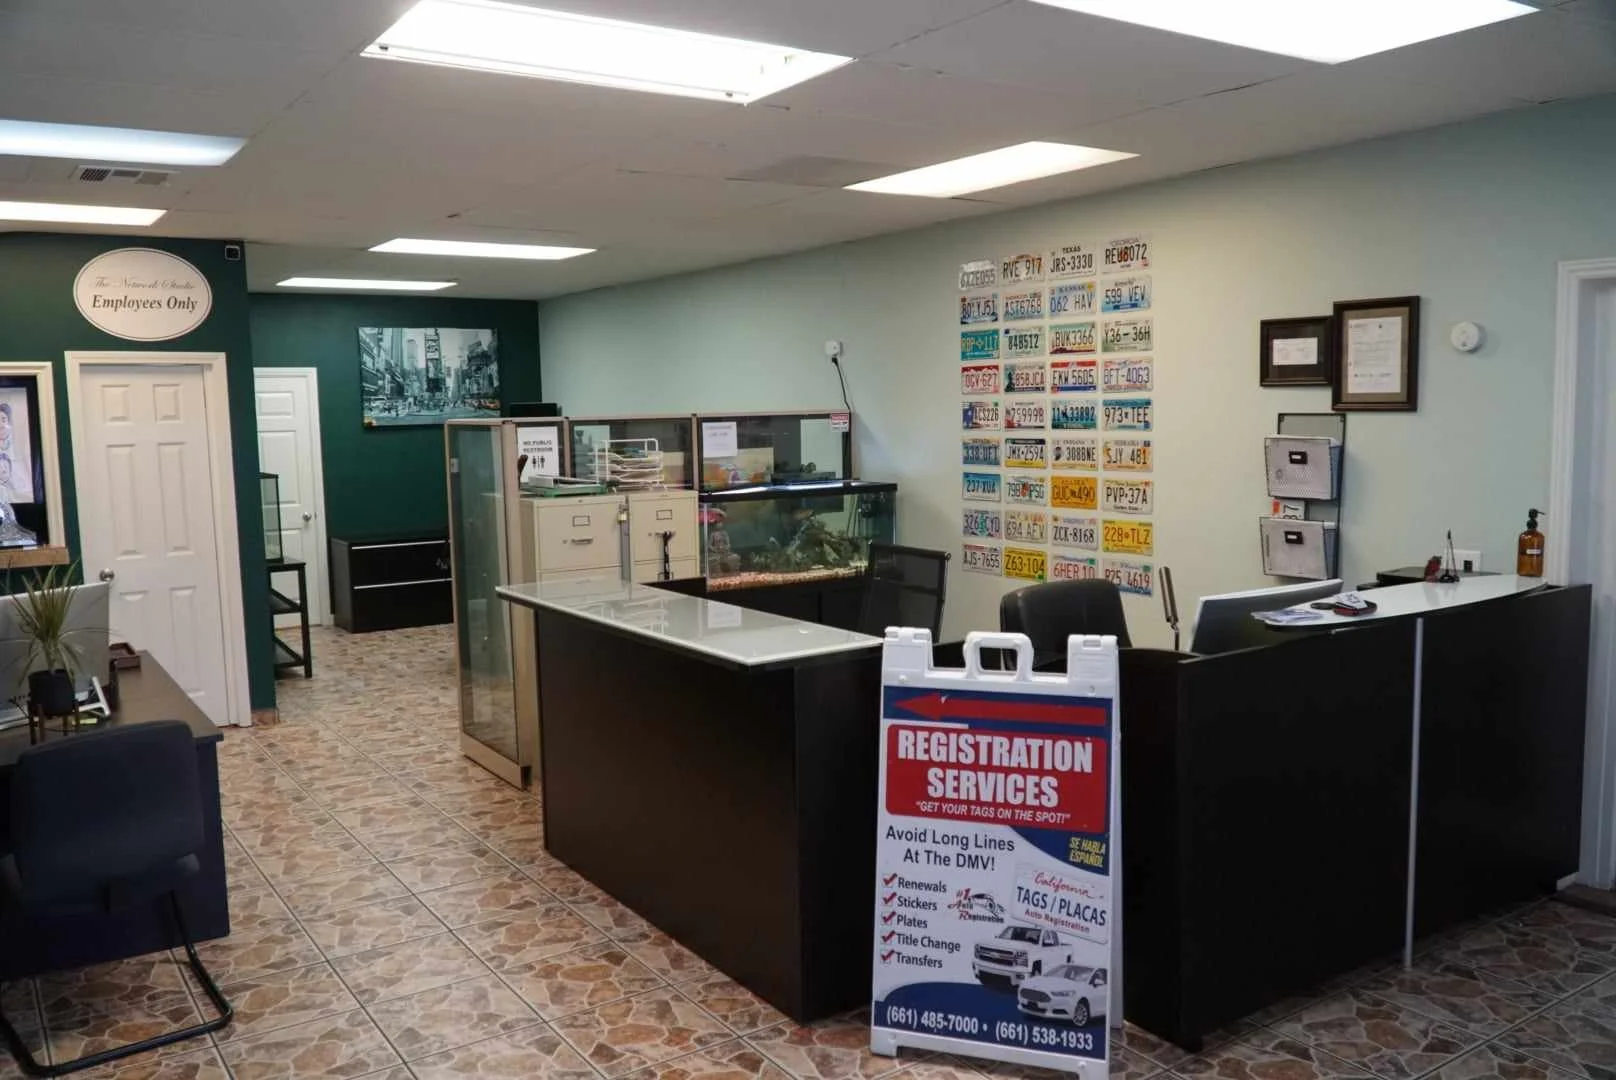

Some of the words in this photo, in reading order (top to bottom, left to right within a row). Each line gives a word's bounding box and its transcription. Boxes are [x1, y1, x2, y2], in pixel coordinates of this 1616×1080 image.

[1062, 245, 1081, 255] TEXAS
[1003, 260, 1020, 280] RVE
[1025, 258, 1042, 276] 917
[92, 294, 162, 312] Employees
[166, 296, 198, 313] Only
[898, 729, 1093, 773] REGISTRATION
[927, 767, 1059, 808] SERVICES
[916, 800, 940, 812] "GET
[941, 803, 968, 815] YOUR
[969, 805, 995, 818] TAGS
[997, 807, 1013, 818] ON
[1014, 808, 1034, 821] THE
[1035, 811, 1071, 824] SPOT!"
[886, 825, 927, 843] Avoid
[932, 829, 969, 851] Long
[974, 833, 1015, 851] Lines
[1069, 836, 1081, 849] SE
[1081, 839, 1106, 855] HABLA
[903, 848, 920, 864] At
[924, 849, 951, 867] The
[956, 853, 995, 871] DMV!
[1069, 849, 1104, 868] ESPAÑOL
[898, 877, 947, 893] Renewals
[1033, 871, 1095, 899] California
[897, 895, 938, 911] Stickers
[1017, 886, 1048, 910] TAGS
[1058, 898, 1107, 926] PLACAS
[897, 914, 929, 929] Plates
[1024, 908, 1042, 920] Auto
[1044, 913, 1090, 933] Registration
[896, 933, 919, 946] Title
[920, 936, 961, 954] Change
[896, 952, 943, 969] Transfers
[886, 1005, 918, 1029] (661)
[920, 1010, 979, 1034] 485-7000
[995, 1021, 1028, 1045] (661)
[1032, 1026, 1094, 1051] 538-1933
